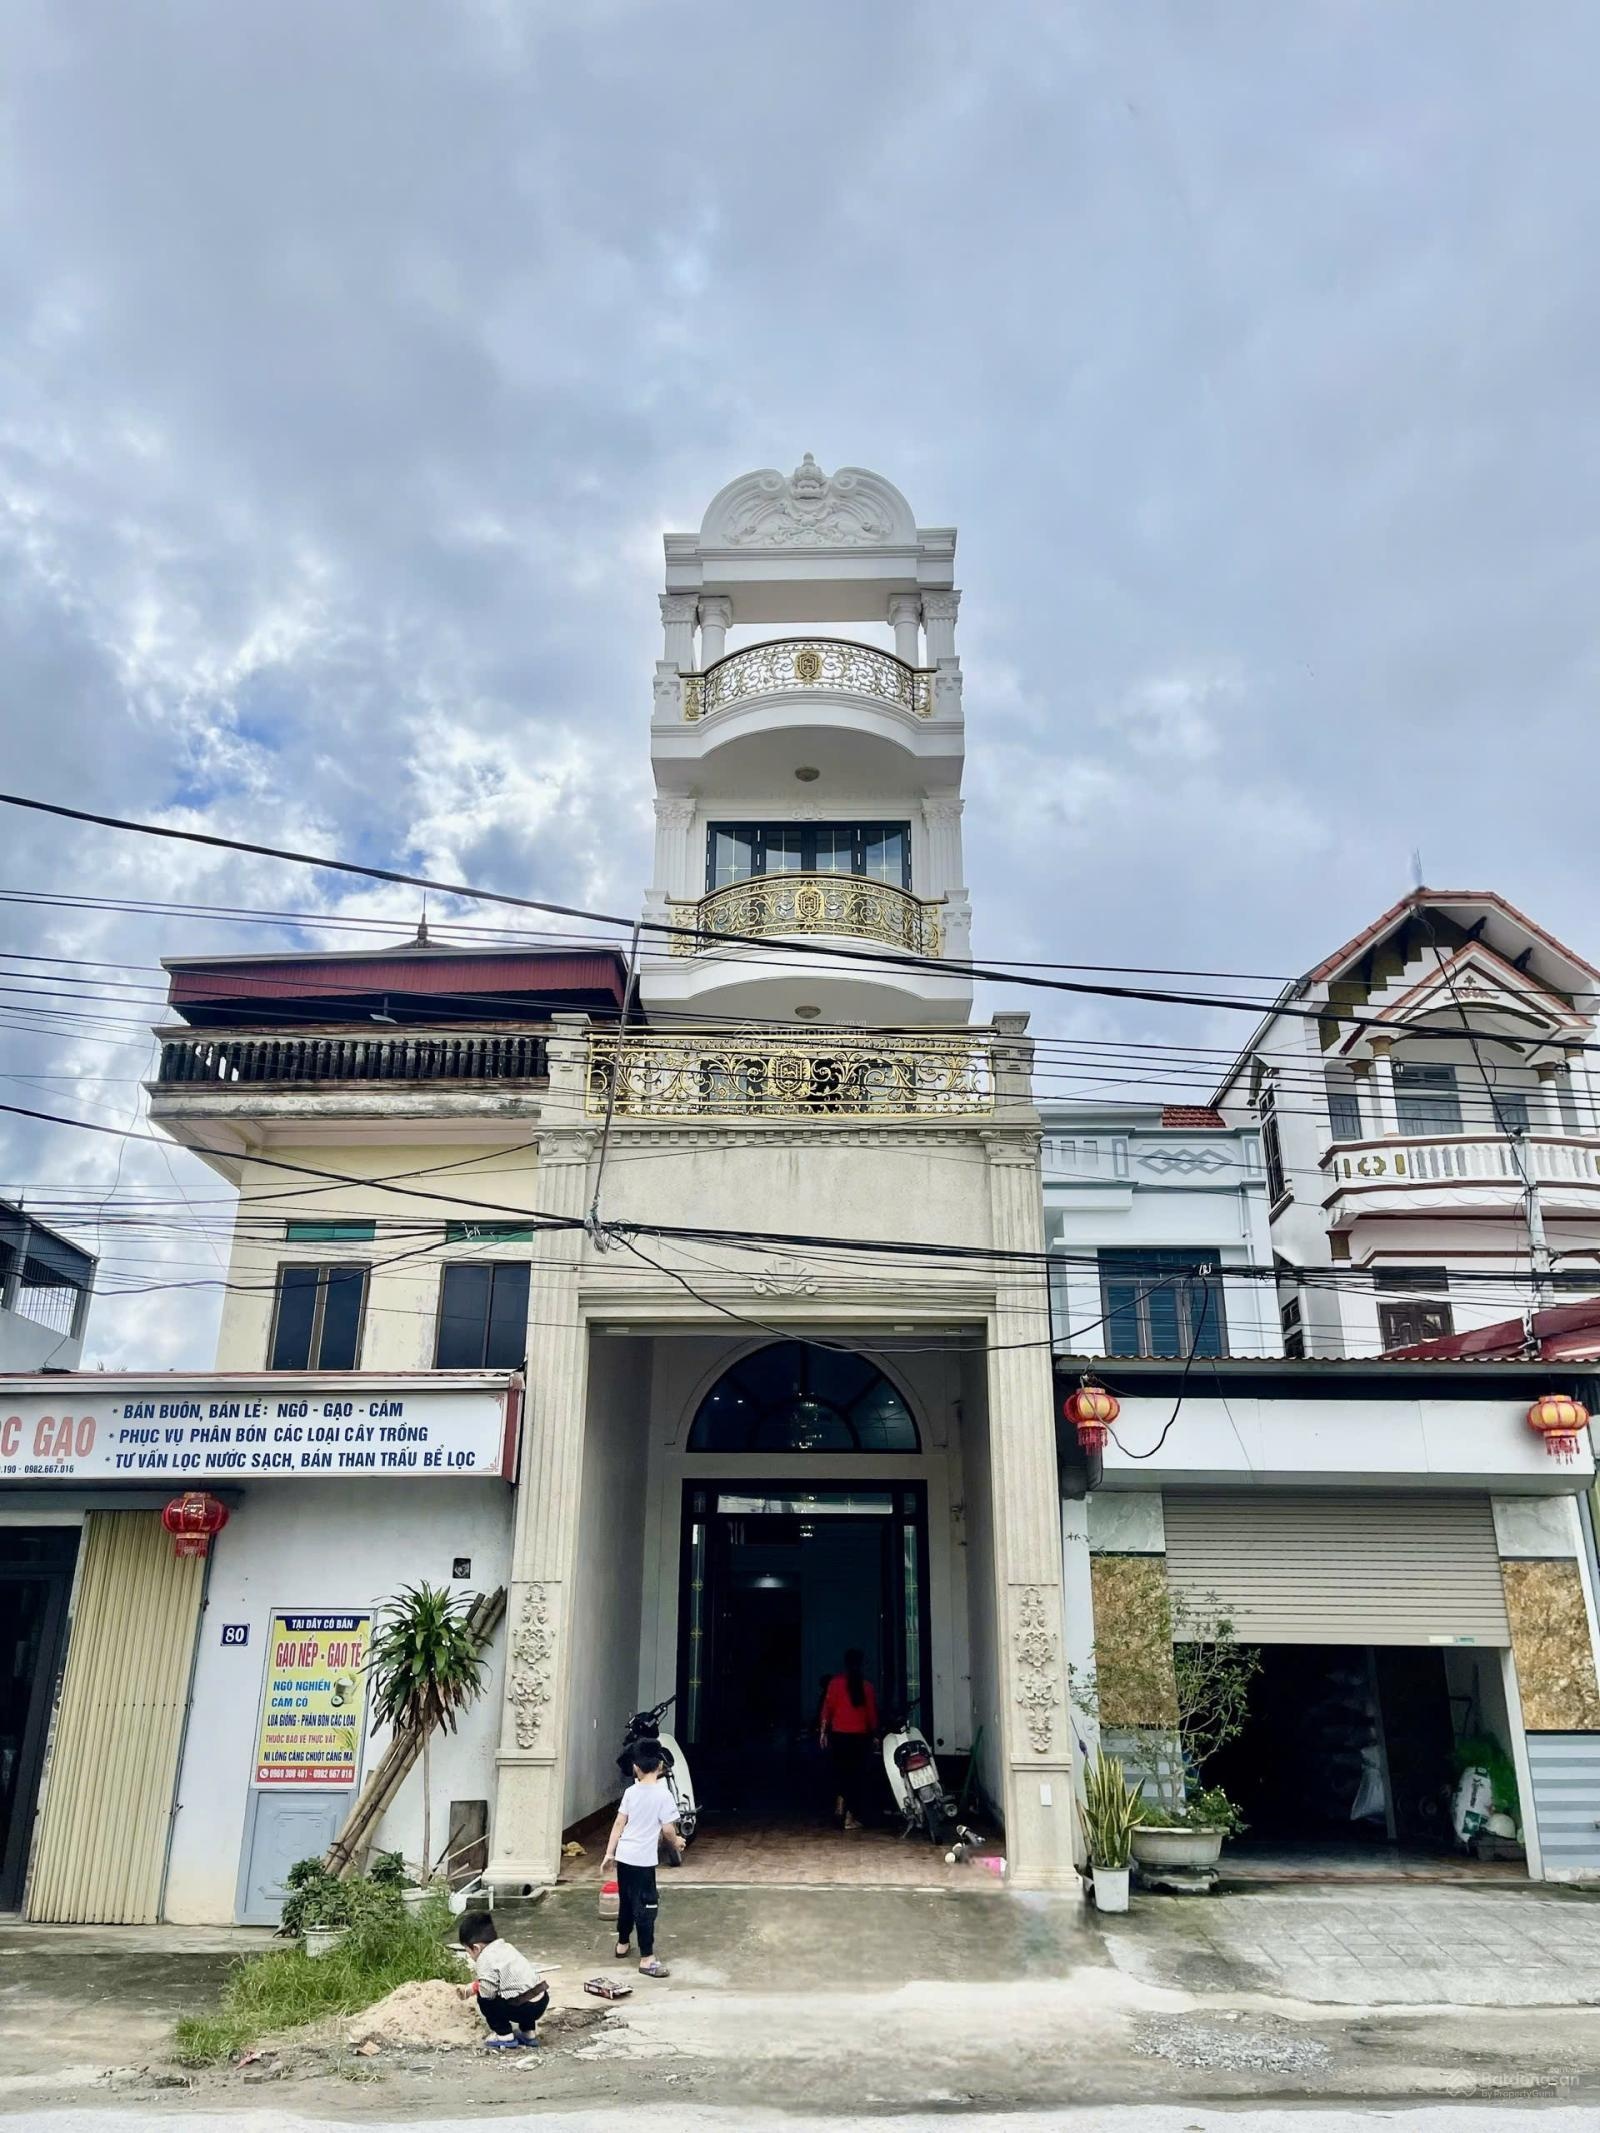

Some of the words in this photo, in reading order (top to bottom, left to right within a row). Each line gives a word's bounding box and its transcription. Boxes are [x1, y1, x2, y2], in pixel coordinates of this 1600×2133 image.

[123, 1400, 156, 1419] BÁN
[159, 1400, 203, 1422] BUÔN,
[208, 1400, 240, 1418] BÁN
[277, 1399, 308, 1418] NGÔ
[323, 1402, 353, 1421] GẠO
[369, 1399, 404, 1418] CÁM
[33, 1416, 97, 1465] GẠO
[119, 1428, 160, 1447] PHỤC
[165, 1428, 184, 1446] VỤ
[190, 1424, 231, 1443] PHÂN
[235, 1424, 267, 1443] BÓN
[273, 1423, 303, 1442] CÁC
[307, 1427, 340, 1445] LOẠI
[344, 1423, 375, 1442] CÂY
[379, 1422, 429, 1442] TRỒNG
[116, 1451, 136, 1469] TƯ
[138, 1448, 169, 1469] VẤN
[172, 1453, 201, 1472] LỌC
[205, 1448, 247, 1469] NƯỚC
[251, 1452, 295, 1472] SẠCH,
[300, 1448, 333, 1468] BÁN
[338, 1452, 376, 1468] THAN
[380, 1446, 418, 1468] TRẤU
[423, 1443, 445, 1468] BỂ
[447, 1451, 476, 1470] LỌC
[225, 1627, 245, 1643] 80
[292, 1619, 305, 1631] TẠI
[323, 1617, 335, 1629] CÓ
[336, 1617, 354, 1629] BÁN
[275, 1642, 297, 1673] GẠO
[298, 1634, 319, 1668] NẾP
[327, 1642, 348, 1673] GẠO
